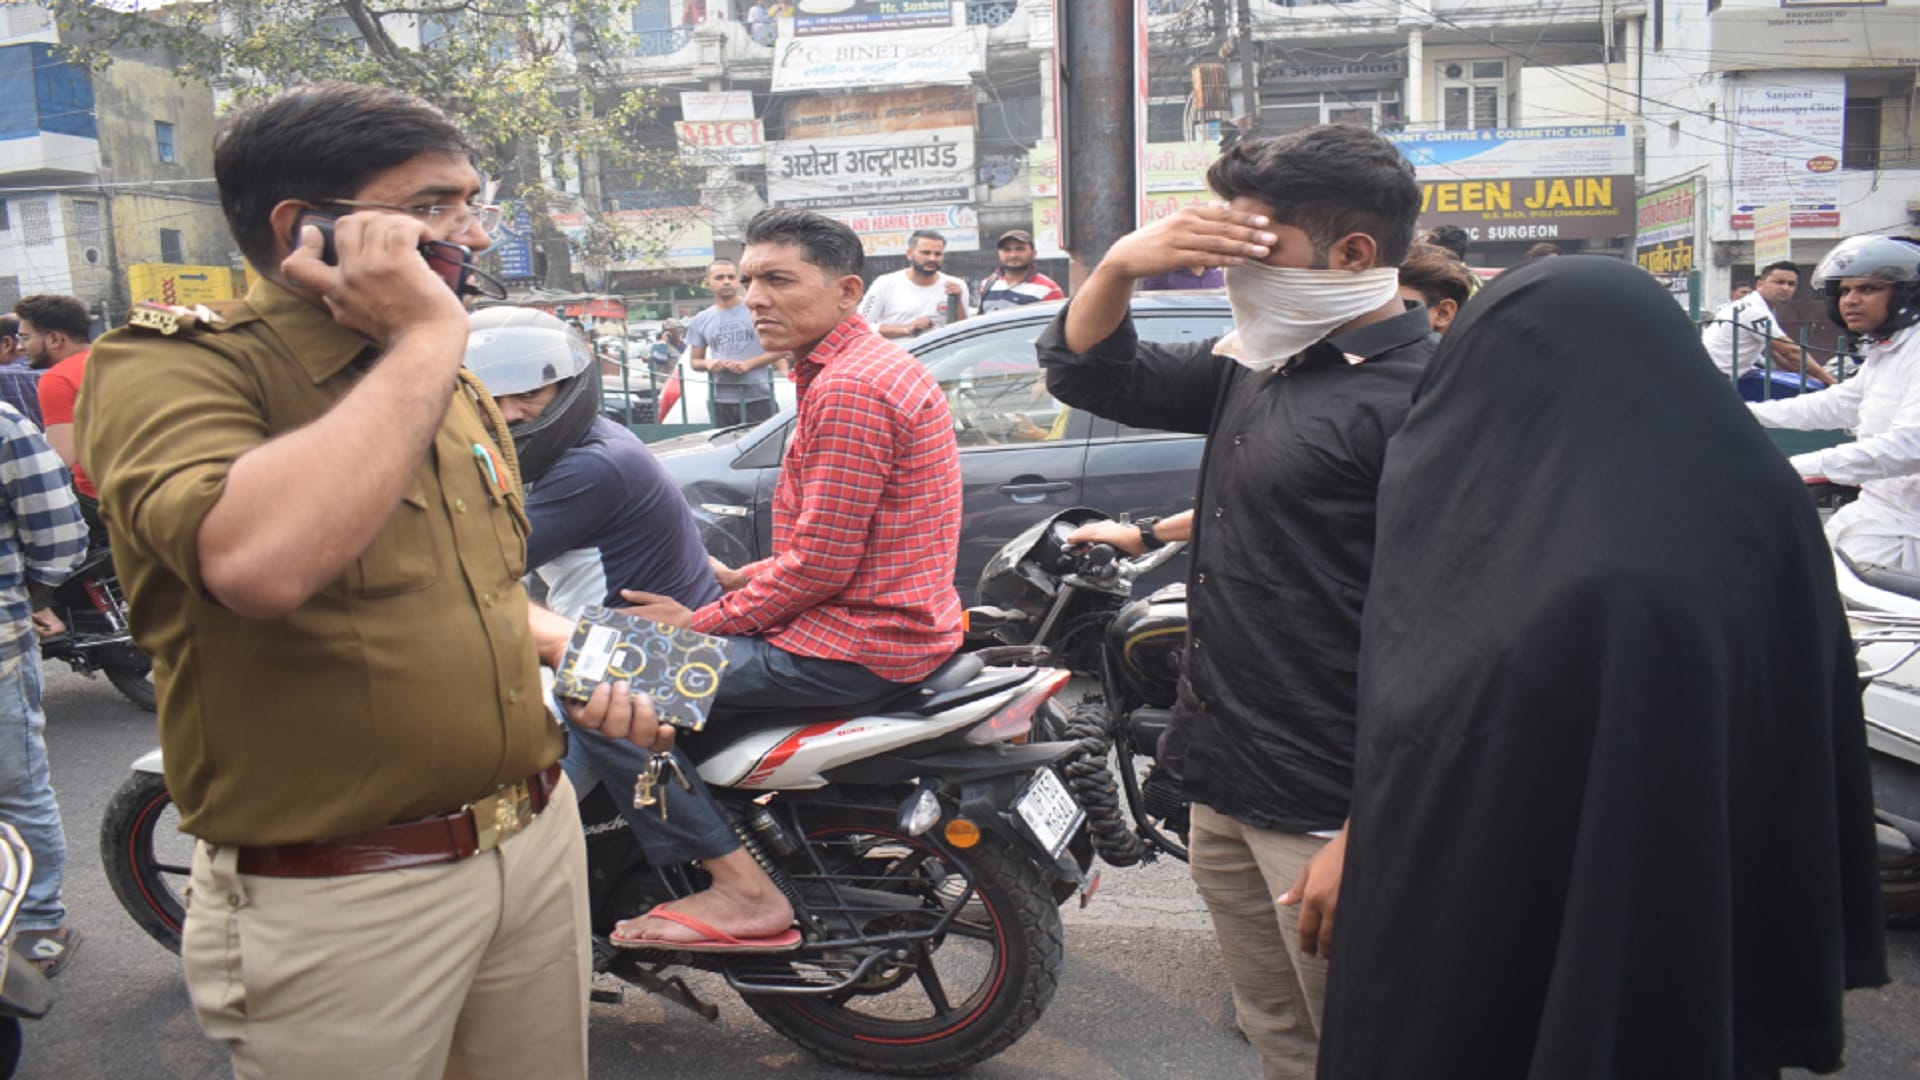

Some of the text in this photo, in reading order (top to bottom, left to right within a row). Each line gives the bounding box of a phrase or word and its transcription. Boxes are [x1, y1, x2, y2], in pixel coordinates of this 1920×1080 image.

[1425, 131, 1478, 142] CENTRE
[1482, 130, 1492, 140] &
[1496, 126, 1566, 139] COSMETIC
[1569, 126, 1616, 137] CLINIC
[781, 145, 839, 178] अरोरा
[845, 135, 959, 176] अल्ट्रासाउंड
[1524, 177, 1613, 210] JAIN
[872, 213, 911, 230] HEARING
[912, 211, 947, 228] CENTER
[1488, 225, 1559, 240] SURGEON
